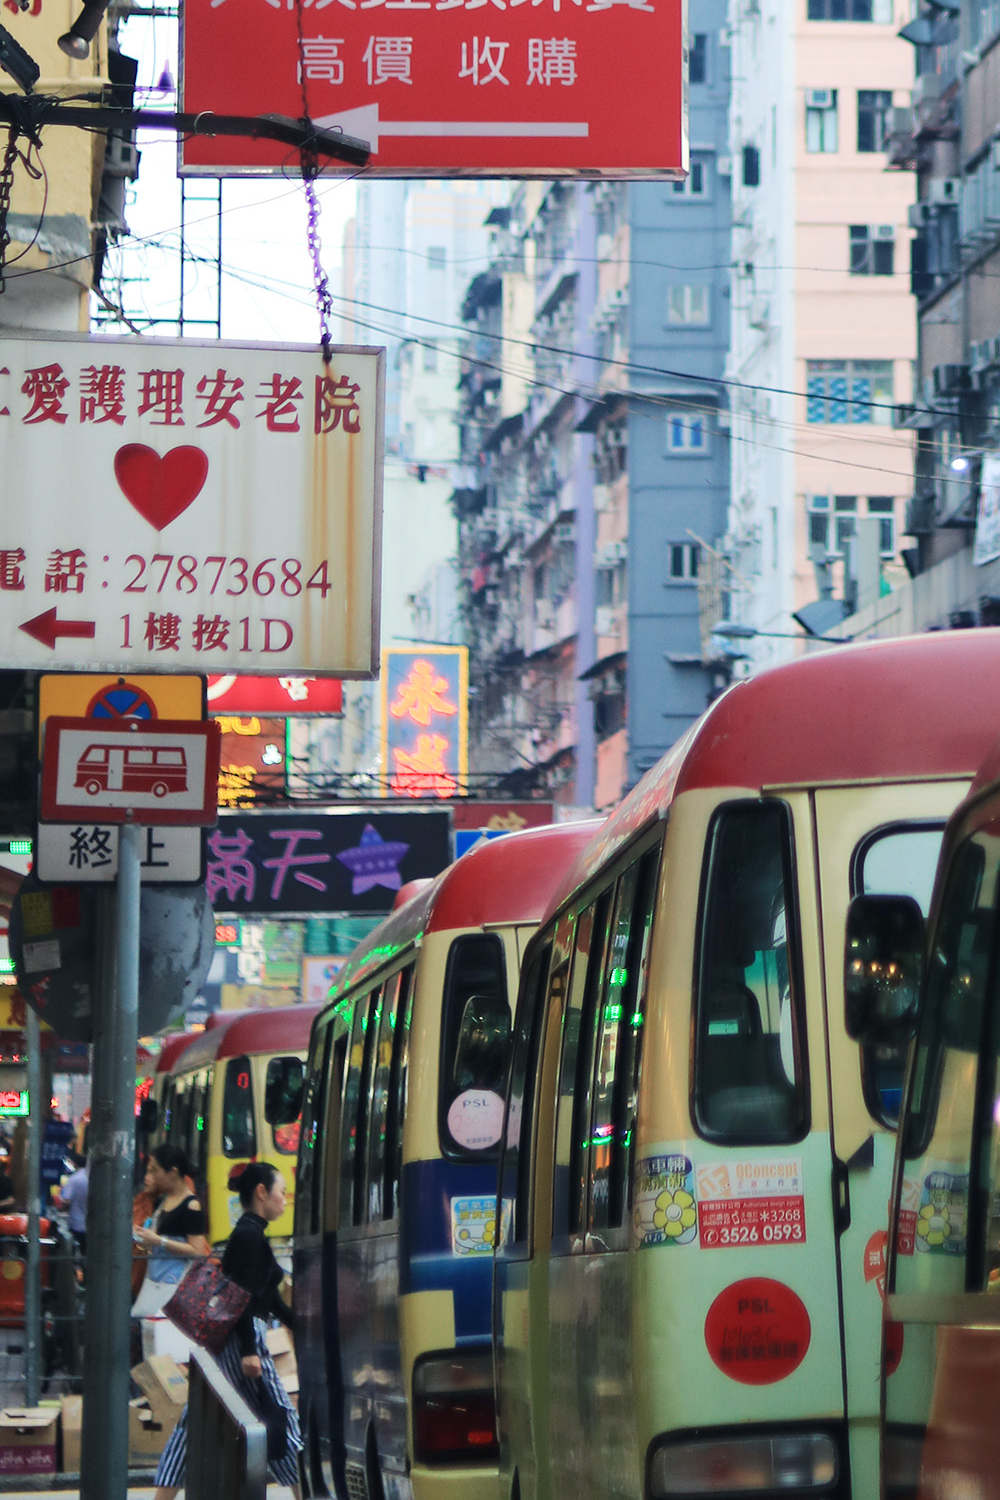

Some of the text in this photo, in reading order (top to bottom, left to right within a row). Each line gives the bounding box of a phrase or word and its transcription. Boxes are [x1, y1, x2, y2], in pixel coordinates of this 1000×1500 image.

[0, 362, 362, 436] 愛護理安老院
[462, 1098, 491, 1108] PSL
[720, 1224, 802, 1244] 3526 0593
[738, 1297, 776, 1315] PSL
